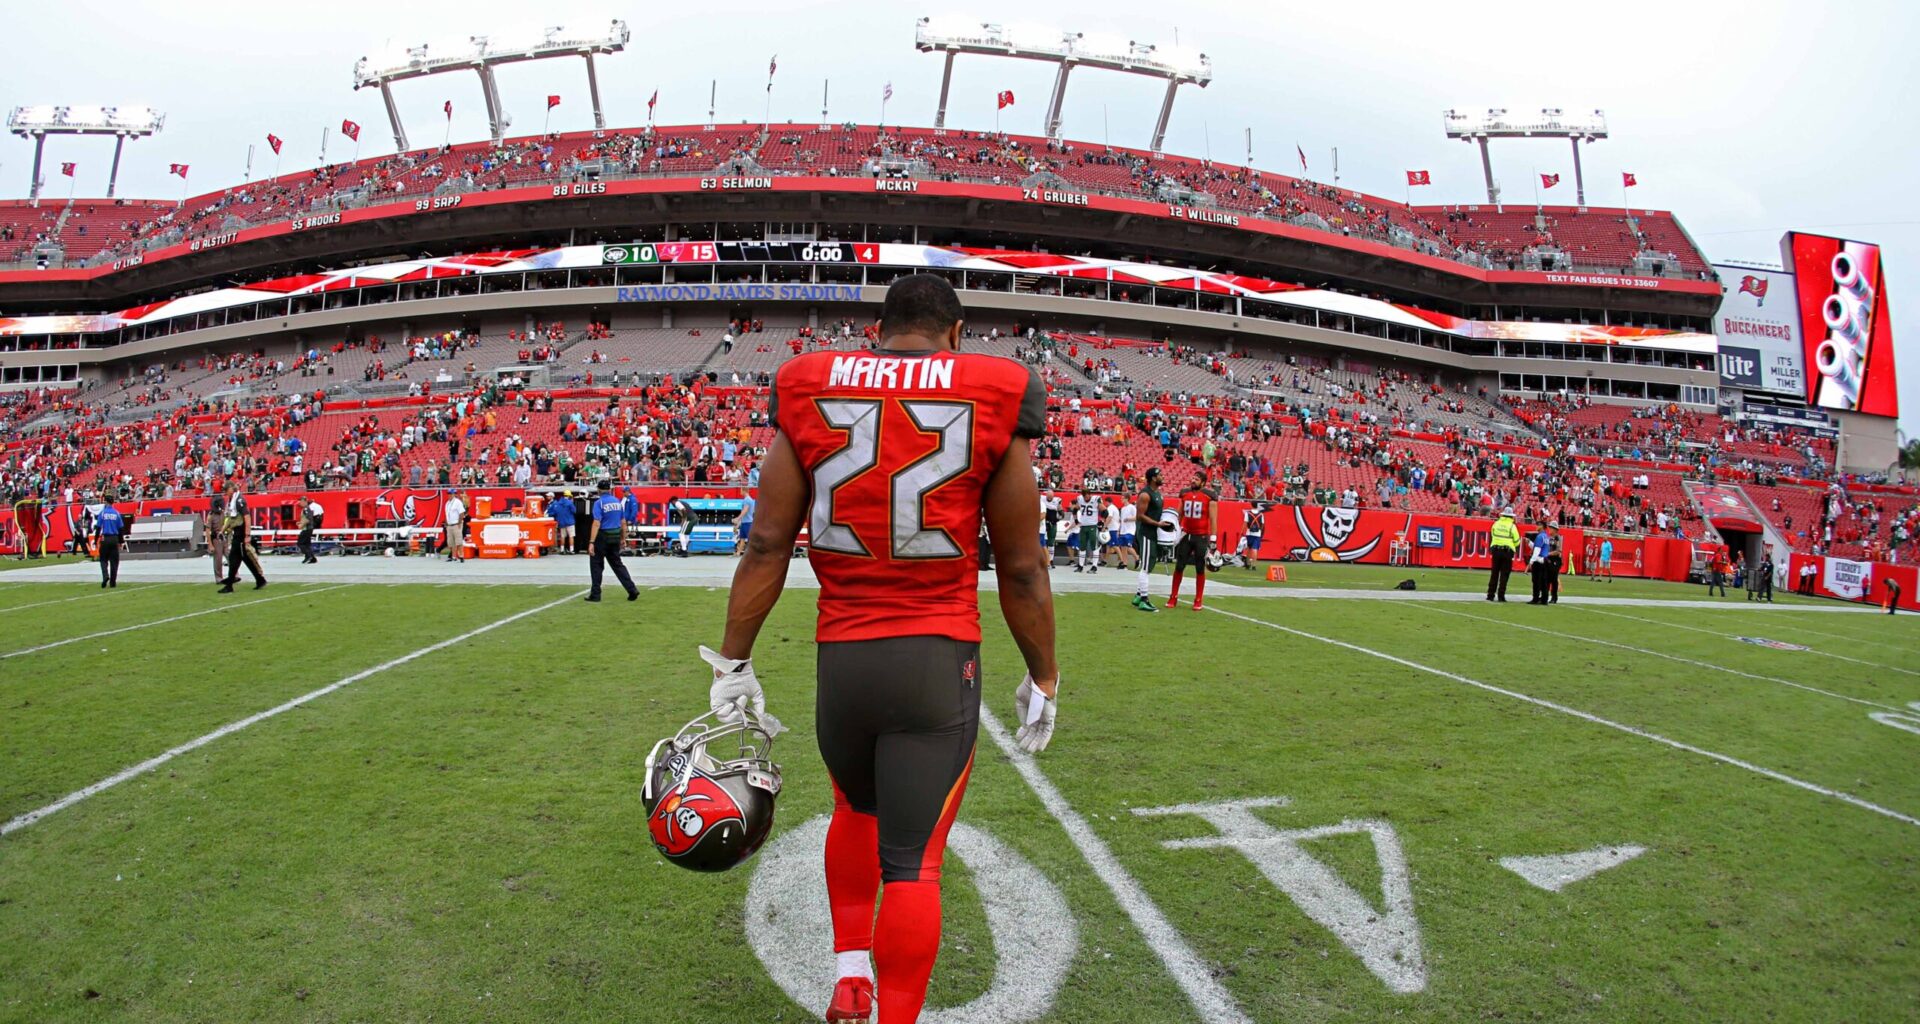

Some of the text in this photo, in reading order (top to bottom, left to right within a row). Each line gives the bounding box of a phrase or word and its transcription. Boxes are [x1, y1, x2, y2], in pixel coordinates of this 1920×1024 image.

[553, 182, 606, 196] 88 GILES
[701, 177, 772, 189] 63 SELMON
[415, 195, 461, 211] 99 SAPP
[1022, 188, 1088, 205] 74 GRUBER
[292, 212, 341, 231] 55 BROOKS
[1169, 206, 1239, 226] 12 WILLIAMS
[190, 232, 238, 251] 40 ALSTOTT
[632, 246, 653, 261] 10
[692, 245, 713, 260] 15
[802, 247, 842, 261] 0:00
[862, 247, 874, 260] 4
[112, 255, 143, 270] 47 LYNCH
[1546, 274, 1659, 288] TEXT FAN ISSUES TO 33607
[617, 285, 862, 301] RAYMOND JAMES STADIUM
[1724, 318, 1791, 341] BUCCANEERS
[1720, 353, 1755, 380] Lite
[1777, 356, 1793, 367] IT'S
[829, 356, 955, 389] MARTIN
[1771, 366, 1801, 379] MILLER
[1777, 378, 1797, 389] TIME
[809, 396, 975, 561] 22
[1080, 505, 1093, 516] 76
[1184, 500, 1203, 519] 88
[1272, 567, 1285, 580] 30
